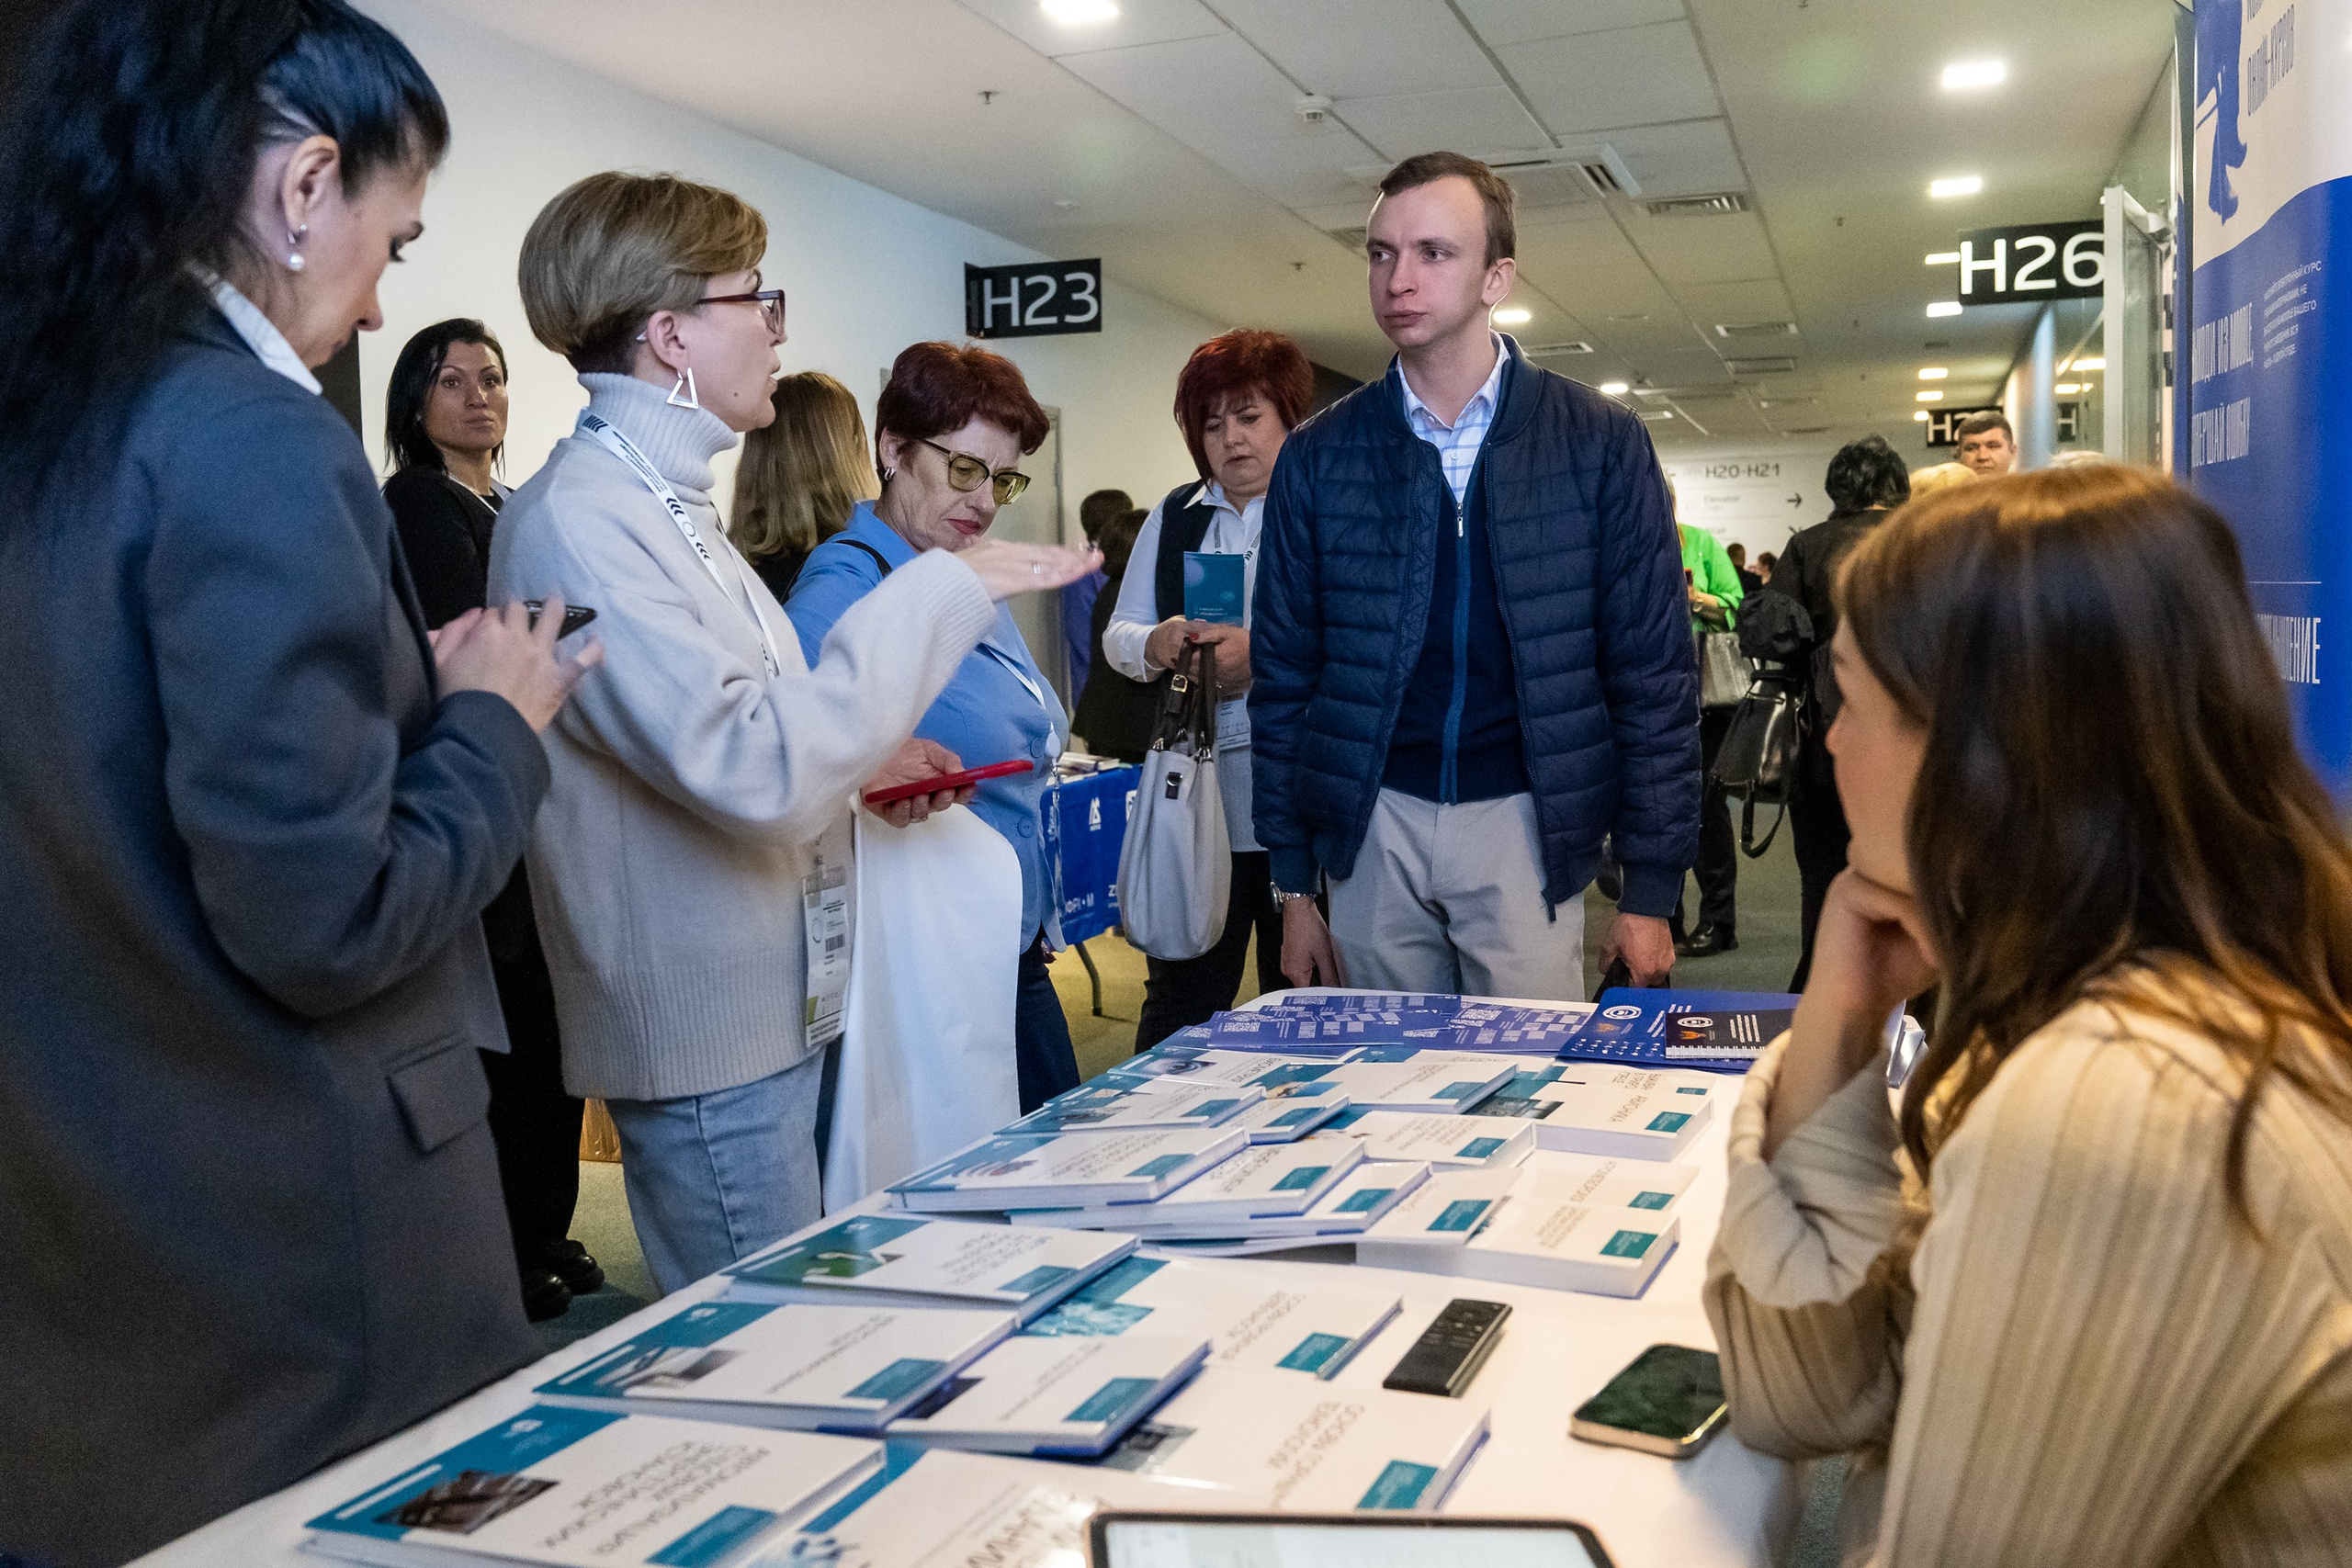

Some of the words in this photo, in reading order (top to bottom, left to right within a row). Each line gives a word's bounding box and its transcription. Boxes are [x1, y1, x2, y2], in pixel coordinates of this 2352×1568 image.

[1960, 232, 2105, 295] H26
[983, 272, 1099, 329] H23
[1705, 463, 1780, 479] H20-H21
